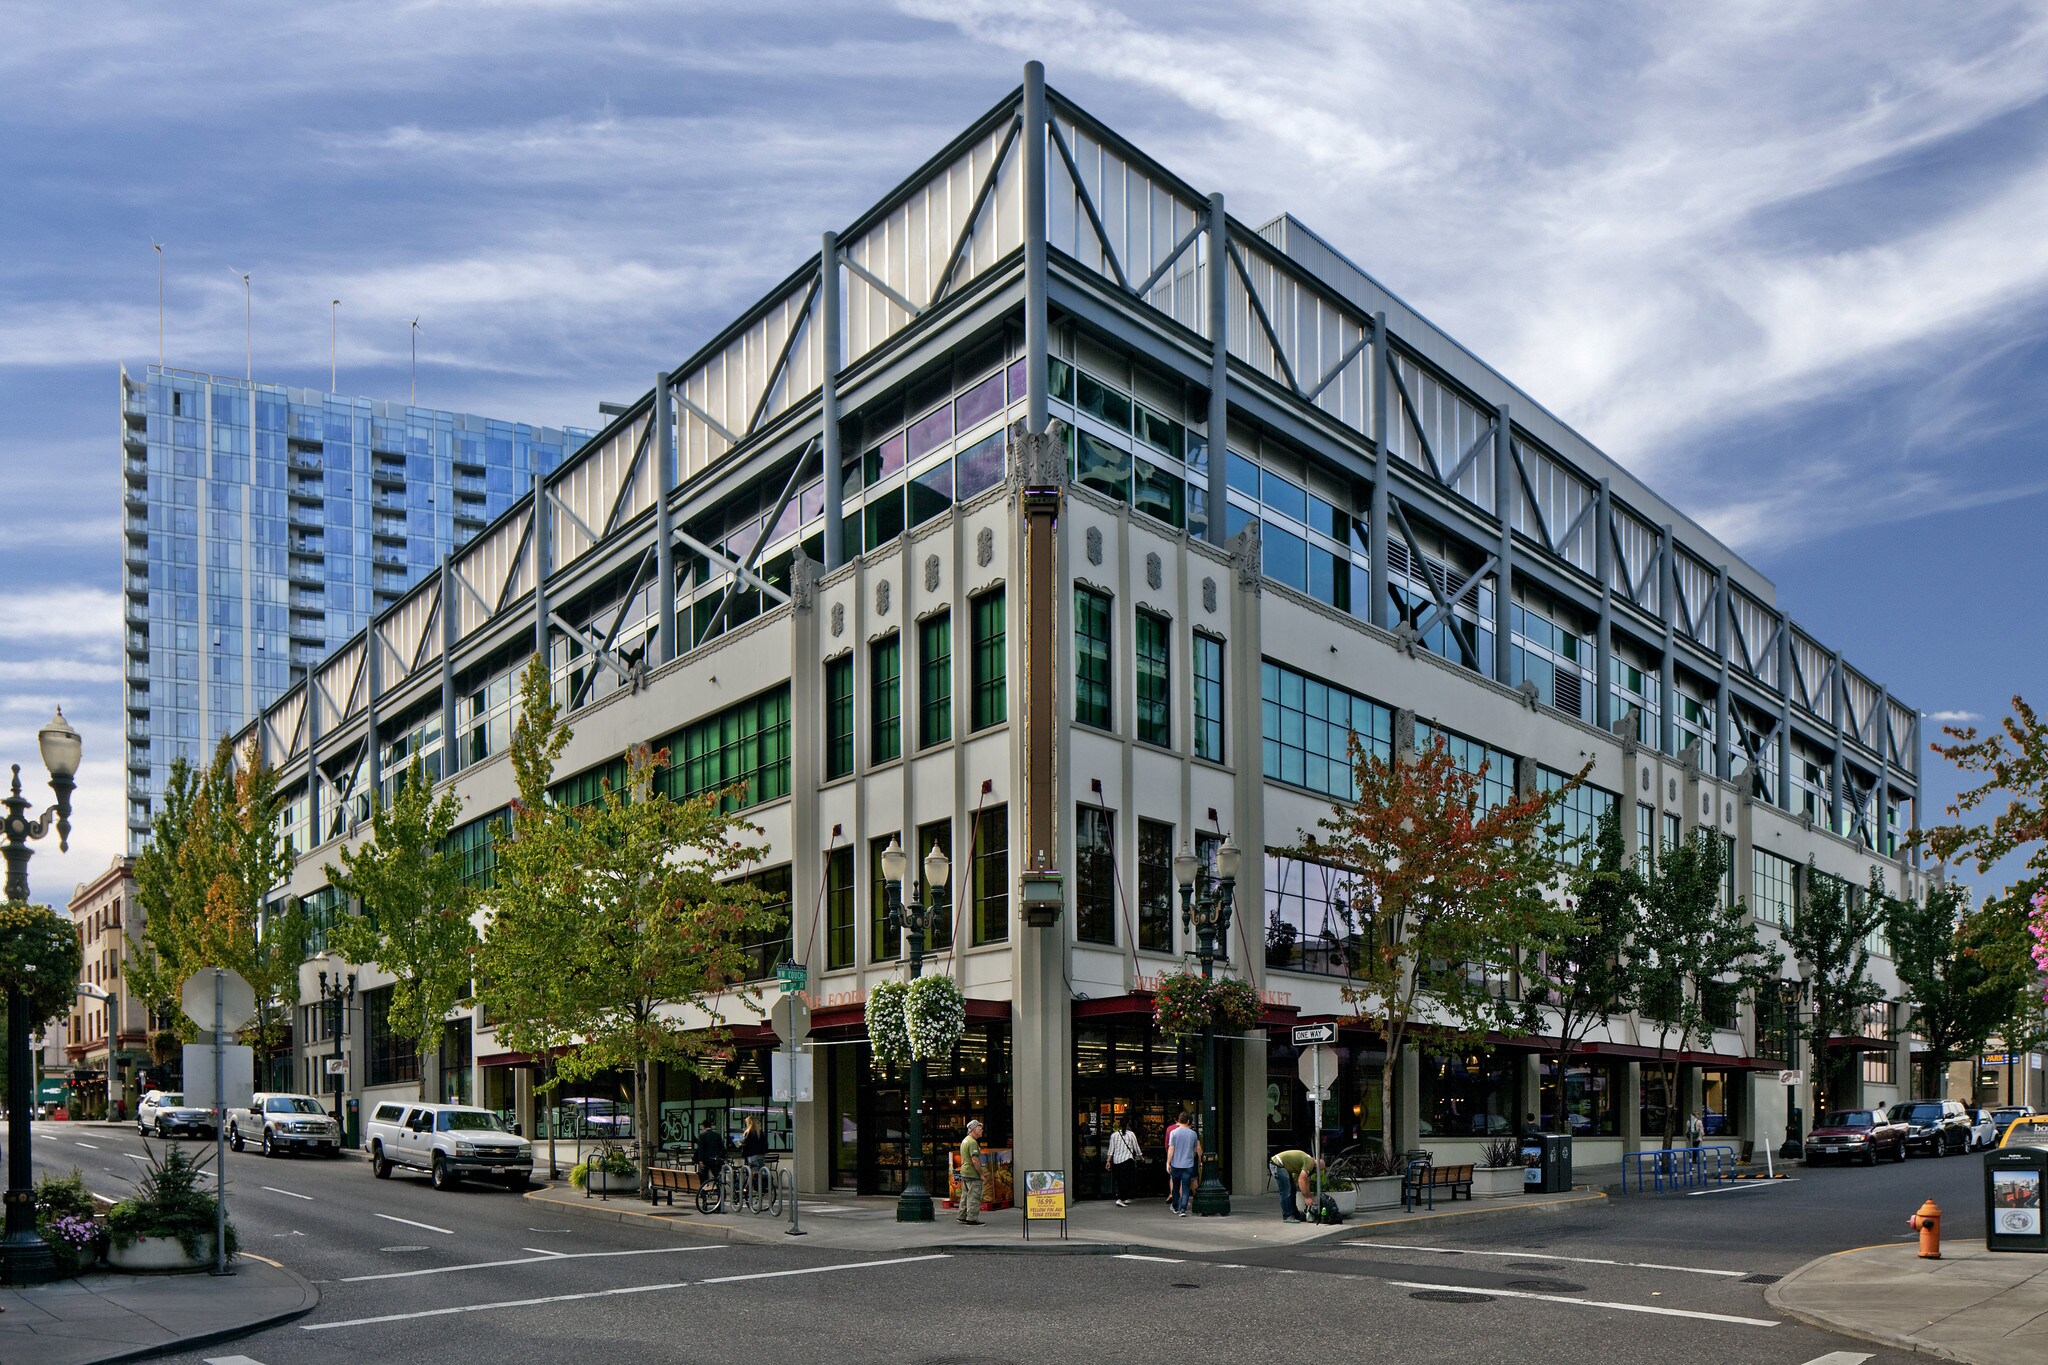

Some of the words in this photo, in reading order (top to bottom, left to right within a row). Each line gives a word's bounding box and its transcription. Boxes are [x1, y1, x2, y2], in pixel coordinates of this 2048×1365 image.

[778, 970, 786, 978] NW
[788, 971, 804, 979] COUCH
[1260, 989, 1292, 1006] RKET
[1296, 1032, 1309, 1040] ONE
[1309, 1030, 1322, 1039] WAY
